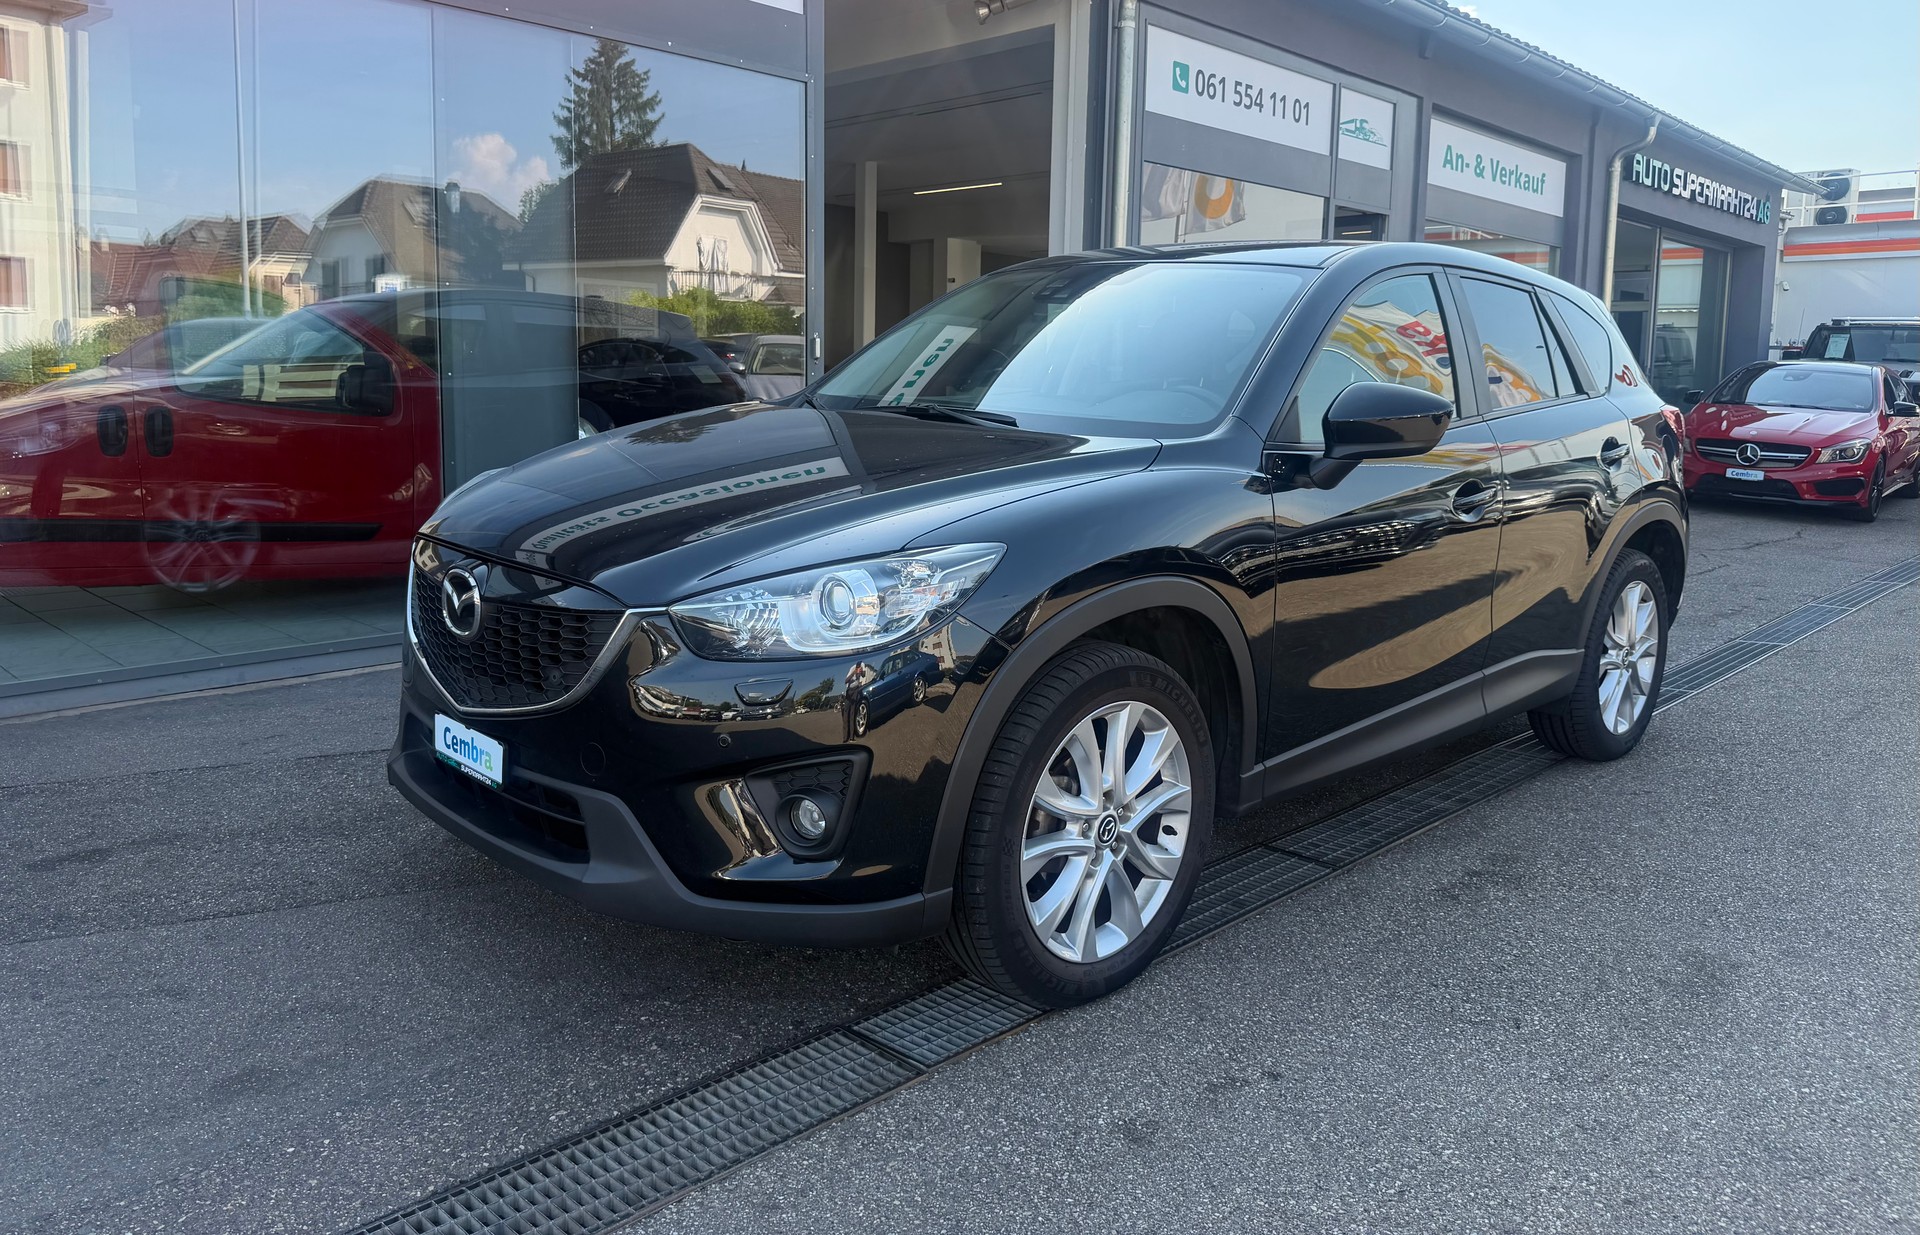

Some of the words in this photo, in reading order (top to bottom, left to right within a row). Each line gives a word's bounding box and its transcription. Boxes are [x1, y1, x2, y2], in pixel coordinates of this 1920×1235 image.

[1195, 69, 1226, 103] 061
[1233, 80, 1264, 113] 554
[1269, 91, 1287, 119] 11
[1293, 98, 1310, 126] 01
[1442, 144, 1470, 173] An-
[1474, 153, 1485, 179] &
[1490, 157, 1546, 195] Verkauf
[1632, 153, 1671, 192] AUTO
[1672, 167, 1758, 220] SUPERMARKT24
[1757, 199, 1771, 224] AG
[1731, 470, 1758, 479] Cembra
[1155, 678, 1208, 743] MICHELIN
[443, 726, 493, 772] Cembra
